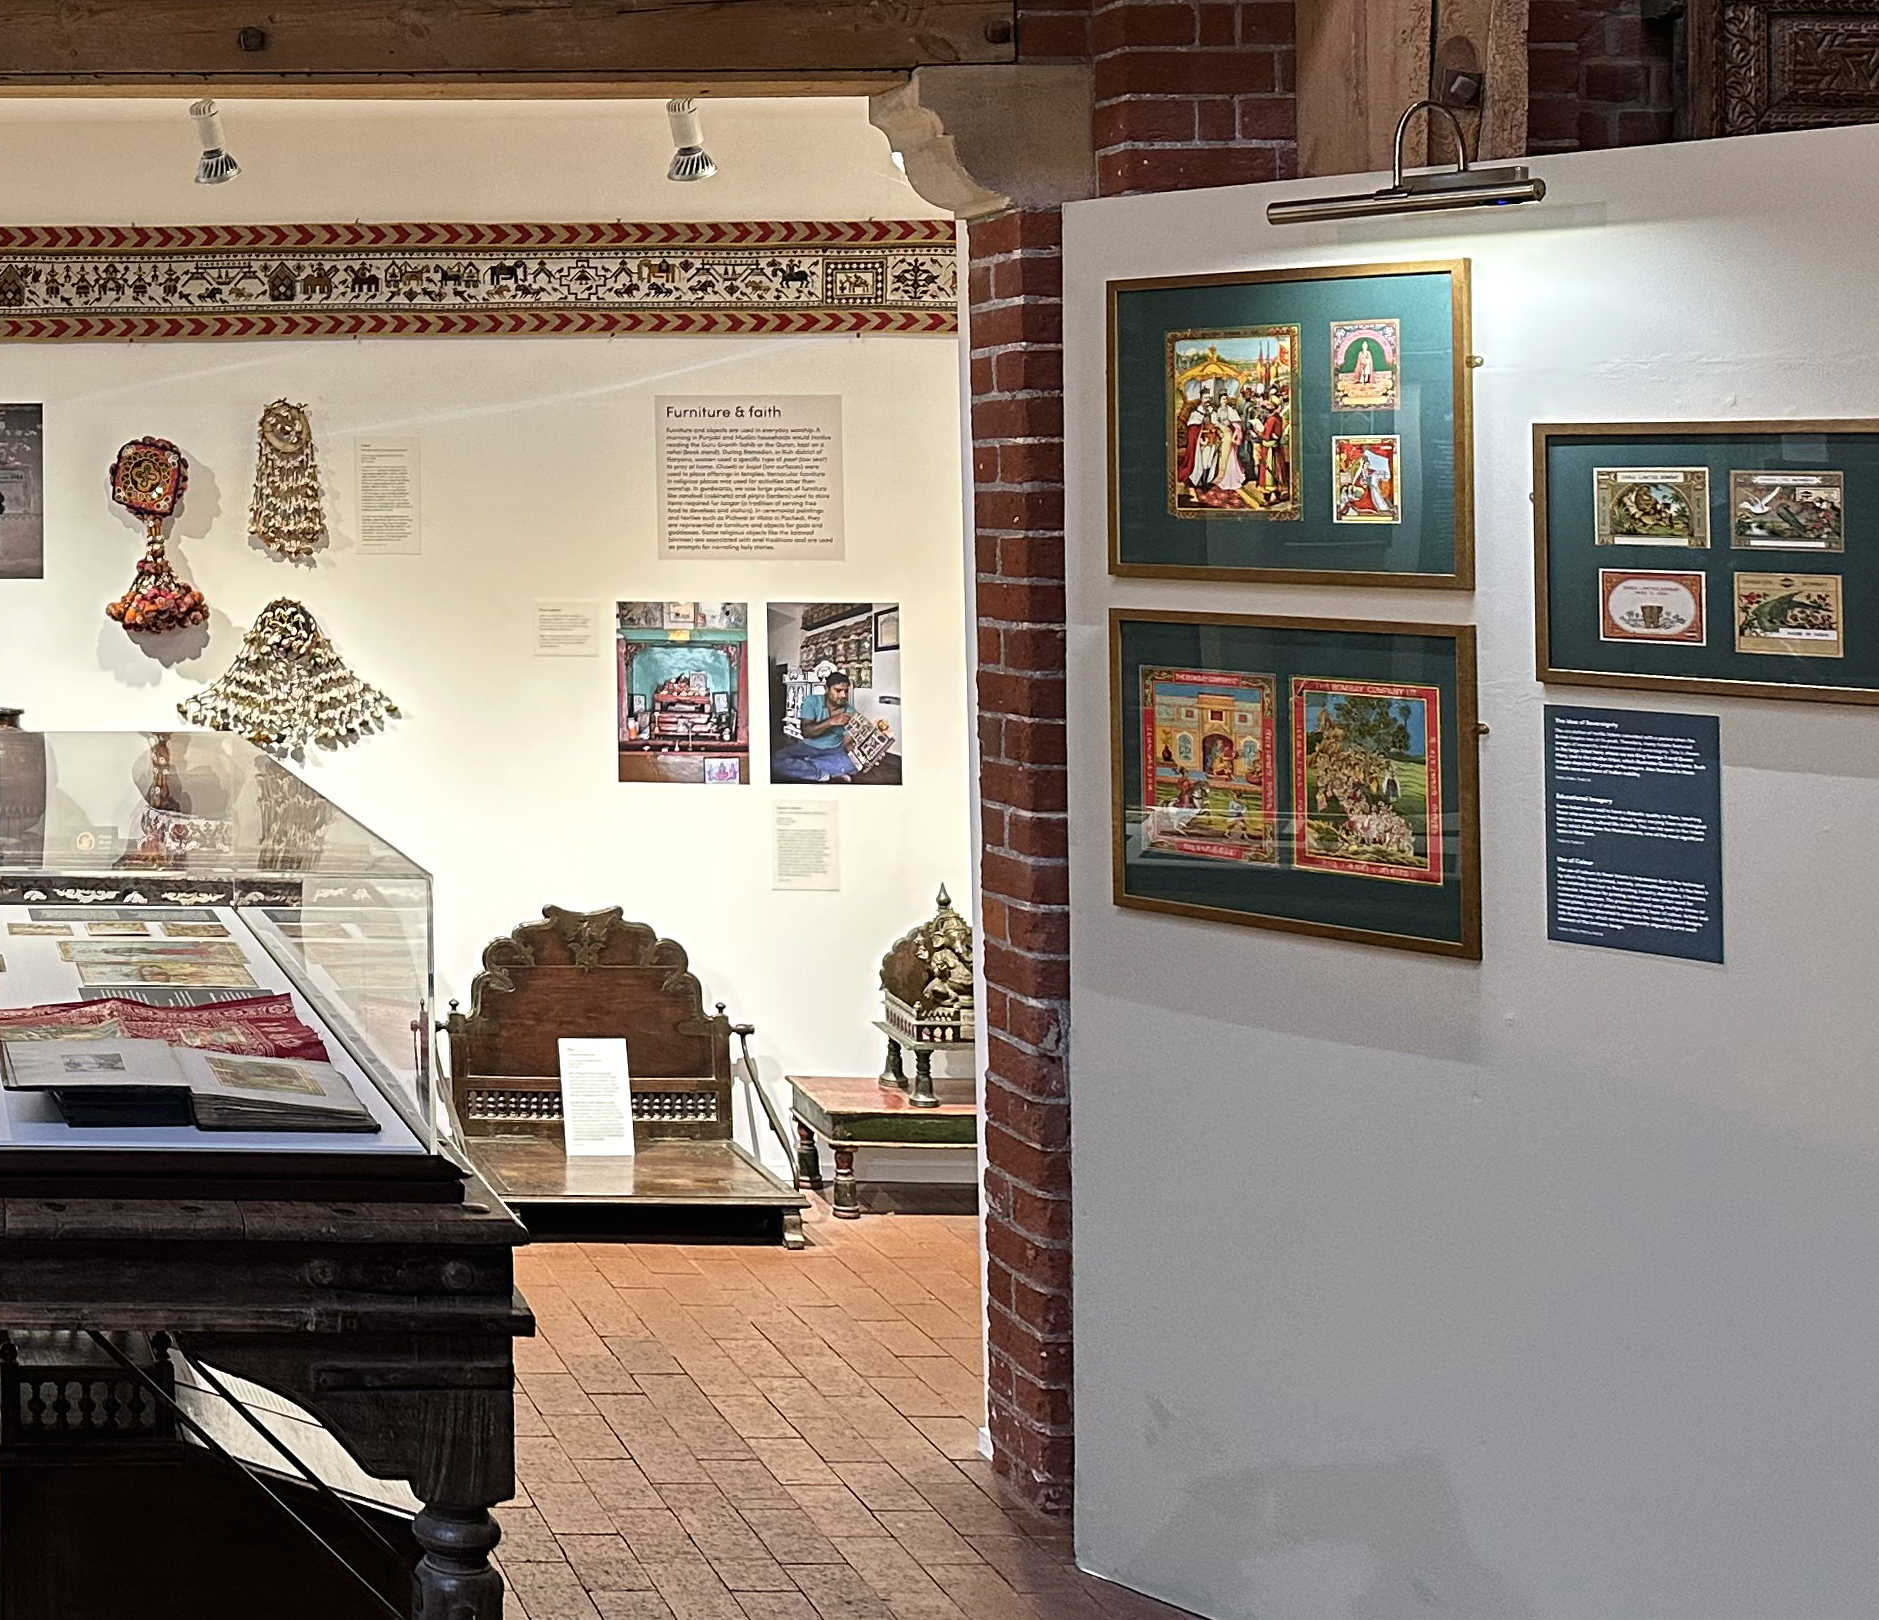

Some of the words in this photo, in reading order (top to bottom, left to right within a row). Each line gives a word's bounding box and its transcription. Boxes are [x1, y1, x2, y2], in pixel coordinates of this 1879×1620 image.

[666, 406, 730, 418] Furniture
[735, 406, 744, 418] &
[749, 405, 781, 418] faith
